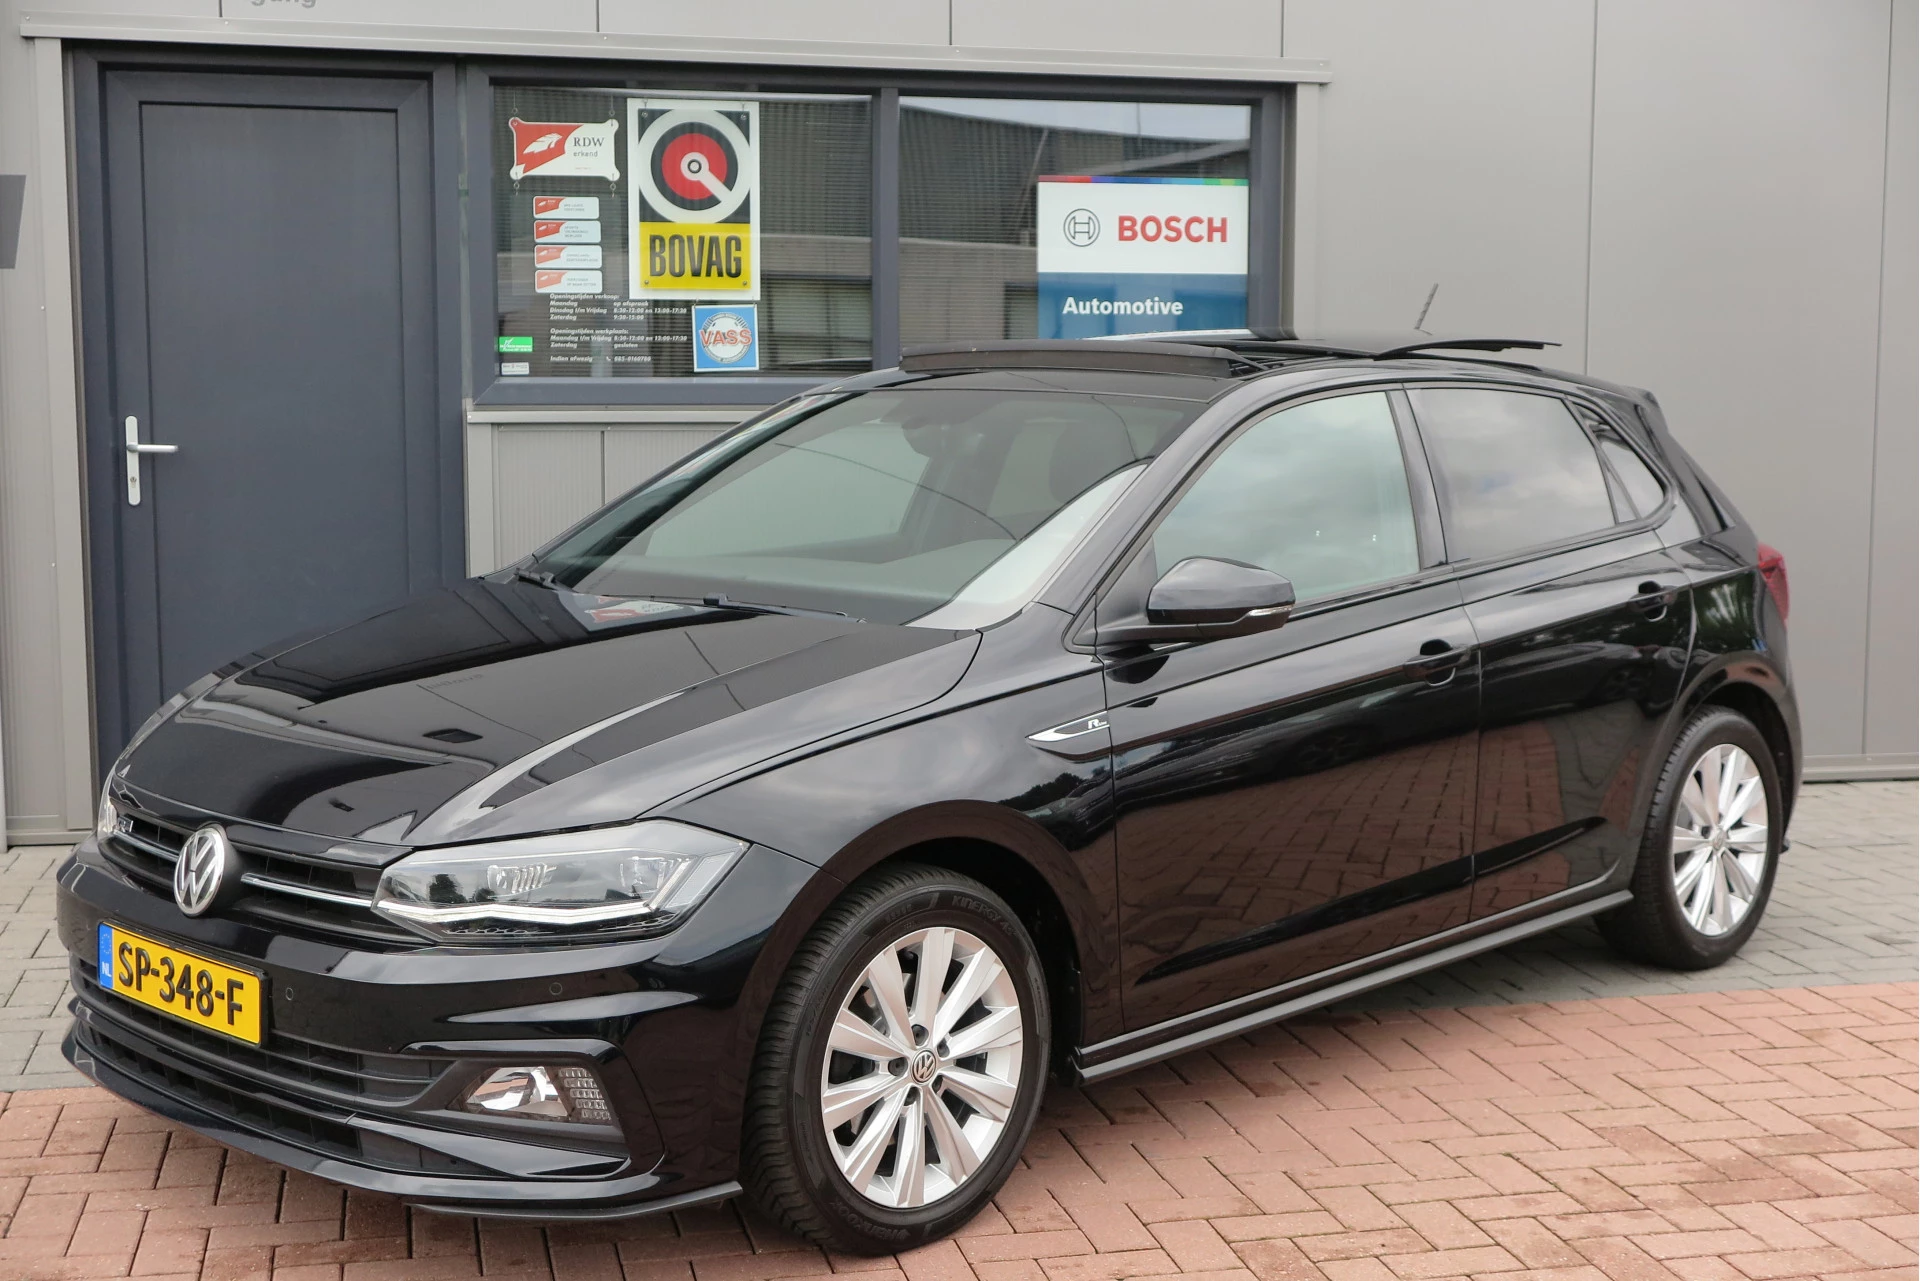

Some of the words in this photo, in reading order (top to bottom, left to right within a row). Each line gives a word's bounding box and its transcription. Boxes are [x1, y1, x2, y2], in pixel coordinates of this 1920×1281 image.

[573, 136, 605, 147] RDW
[1118, 215, 1228, 242] BOSCH
[649, 234, 742, 278] BOVAG
[1062, 296, 1184, 316] Automotive
[699, 328, 752, 347] VASS
[101, 961, 112, 978] NL
[118, 941, 244, 1027] SP-348-F
